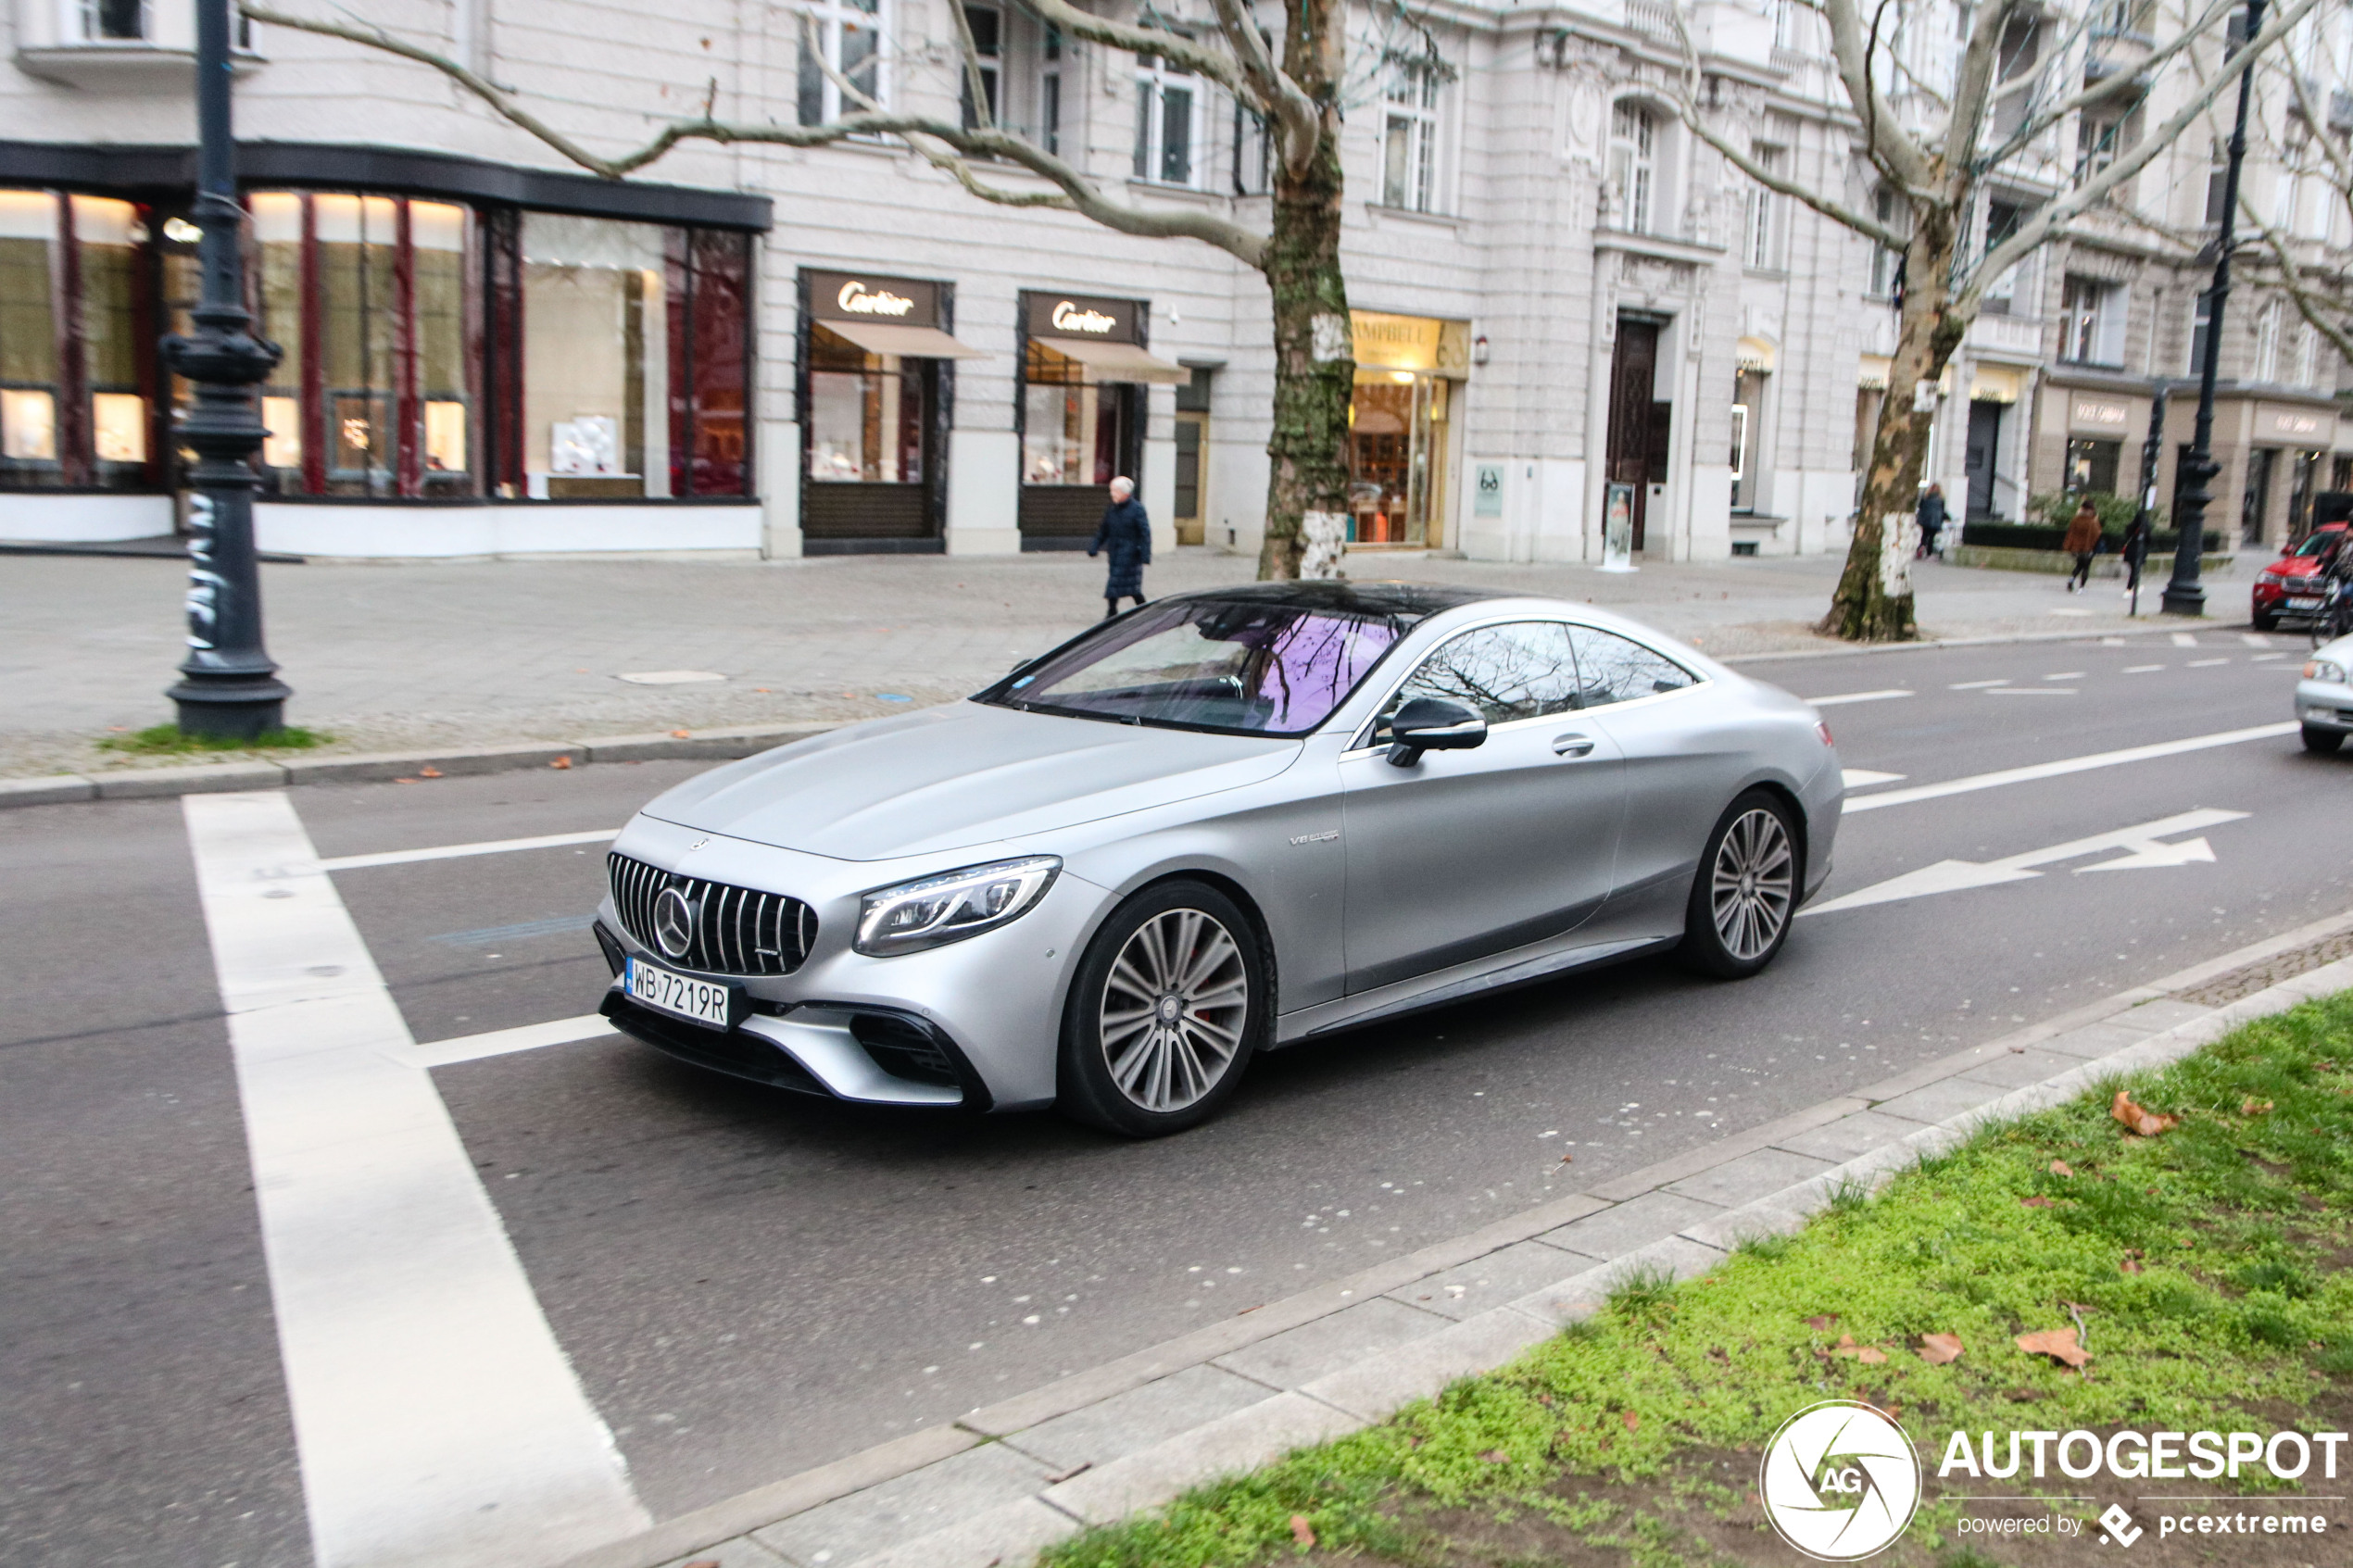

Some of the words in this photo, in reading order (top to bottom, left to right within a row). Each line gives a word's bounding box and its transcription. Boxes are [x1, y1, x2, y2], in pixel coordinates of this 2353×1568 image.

[837, 281, 914, 316] Cartier
[1052, 300, 1116, 333] Cartier
[1354, 320, 1425, 345] AMPBELL
[1290, 835, 1308, 845] V8
[635, 963, 657, 999] WB
[662, 973, 724, 1022] 7219R
